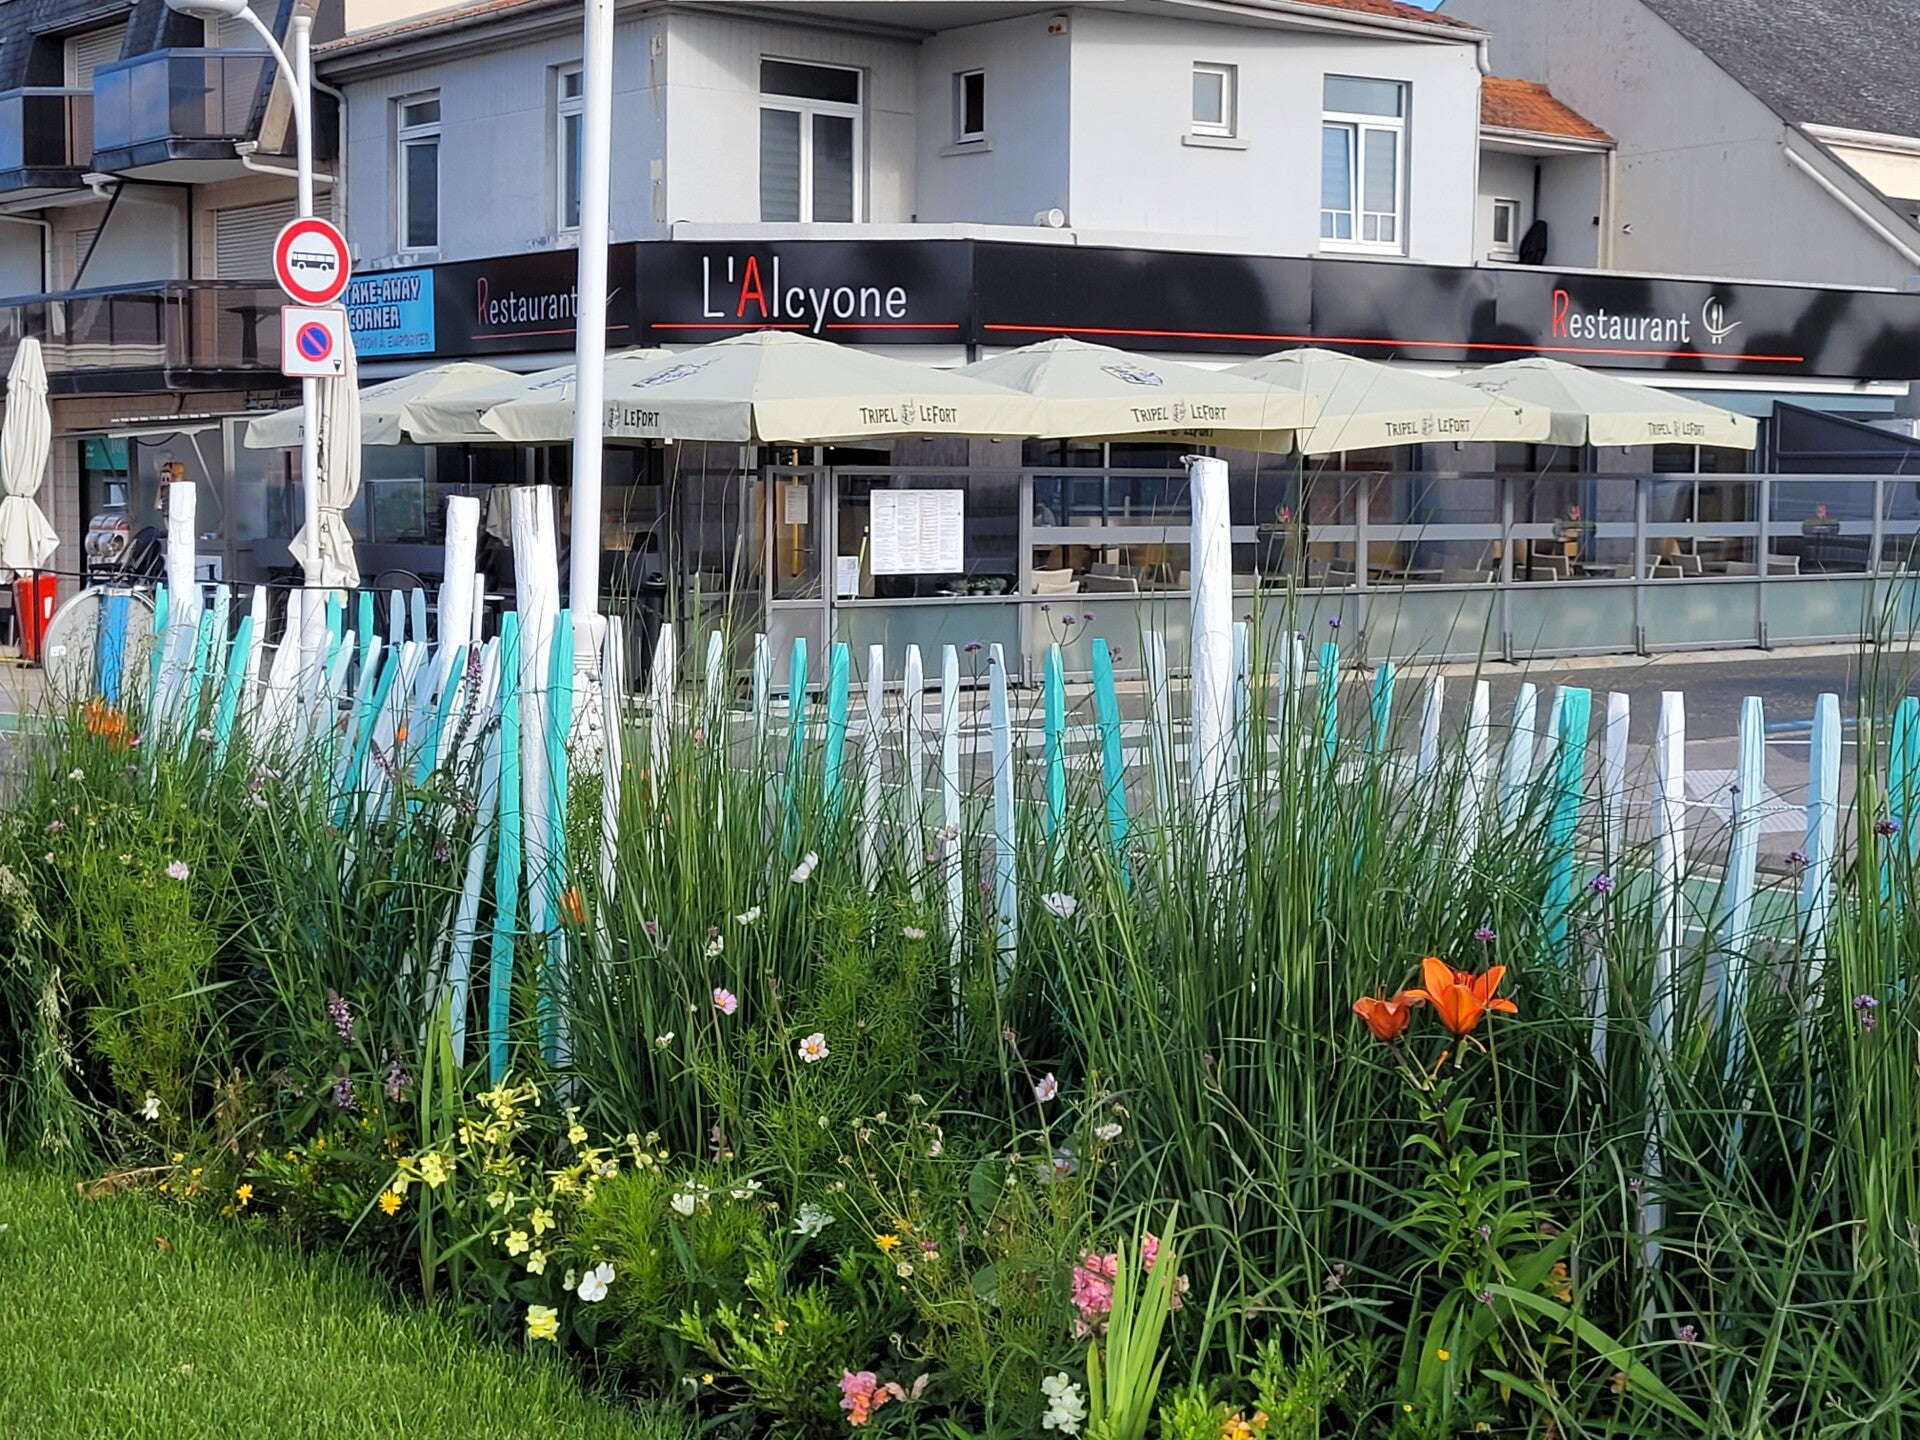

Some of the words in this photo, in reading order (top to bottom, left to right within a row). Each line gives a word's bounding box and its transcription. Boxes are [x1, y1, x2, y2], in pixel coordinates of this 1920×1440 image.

[344, 276, 420, 306] TAKE-AWAY
[477, 277, 577, 325] Restaurant
[703, 256, 906, 334] L'Alcyone
[348, 305, 400, 331] CORNER
[1552, 289, 1691, 343] Restaurant
[859, 407, 898, 424] TRIPEL
[1130, 406, 1169, 423] TRIPEL
